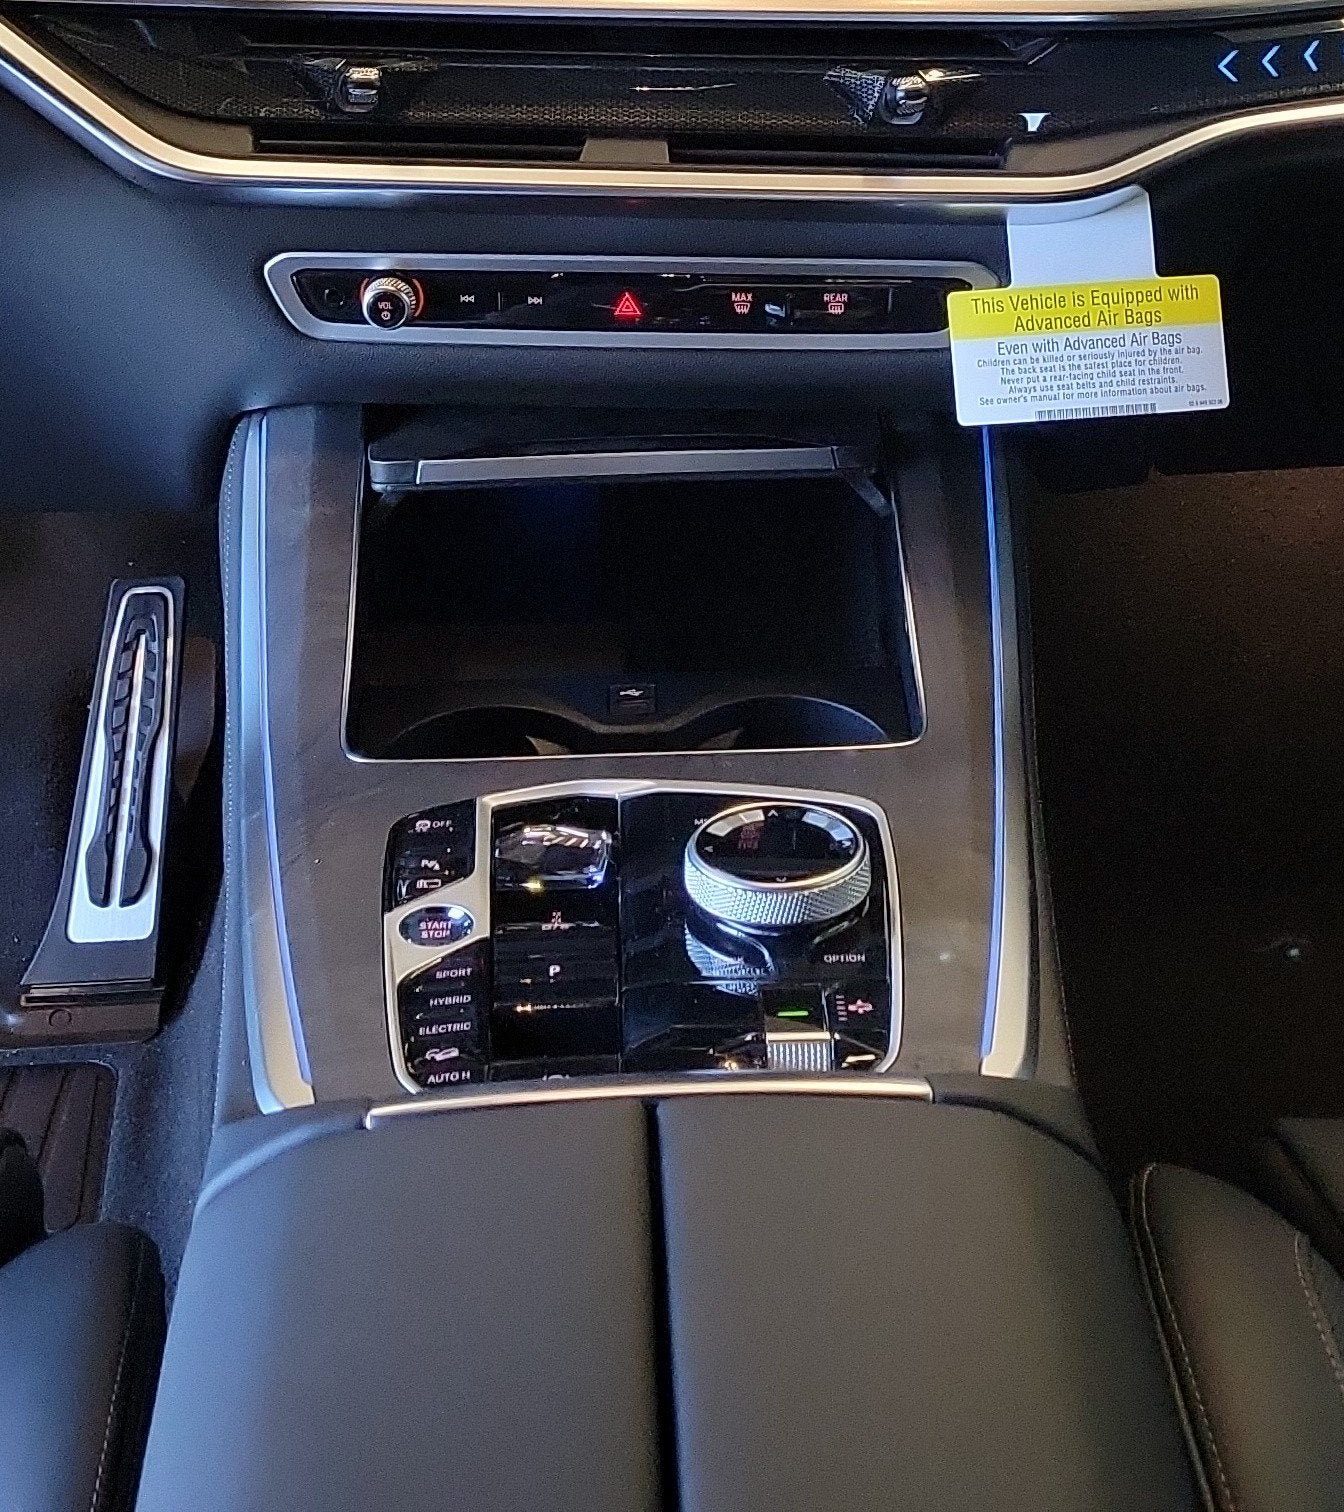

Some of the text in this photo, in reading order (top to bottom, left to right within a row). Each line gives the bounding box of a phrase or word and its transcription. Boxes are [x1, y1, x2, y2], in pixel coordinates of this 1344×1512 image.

[731, 292, 753, 302] MAX
[823, 292, 848, 303] REAR
[971, 284, 1199, 314] This Vehicle is Equipped with
[377, 301, 394, 311] VOL
[1014, 308, 1162, 332] Advanced Air Bags
[997, 331, 1182, 355] Even with Advanced Air Bags
[977, 356, 1011, 368] Children
[1013, 357, 1027, 365] can
[1030, 356, 1039, 364] be
[1042, 353, 1063, 363] killed
[1078, 349, 1114, 361] seriously
[1117, 348, 1145, 360] injured
[1148, 348, 1157, 359] by
[1160, 346, 1171, 355] the
[1174, 345, 1184, 354] air
[1187, 345, 1203, 355] bag.
[1001, 357, 1183, 376] The back seat is the safest place for children.
[1000, 376, 1024, 386] Never
[1026, 375, 1040, 385] put
[1050, 372, 1094, 382] rear-facing
[1096, 369, 1116, 378] child
[1119, 368, 1136, 377] seat
[1138, 367, 1146, 376] in
[1148, 366, 1160, 375] the
[1163, 365, 1184, 374] front.
[1009, 375, 1177, 394] Always use seat belts and child restraints.
[979, 383, 1207, 406] See owner's manual for more information about air bags.
[432, 819, 452, 828] OFF
[419, 921, 452, 930] START
[421, 930, 450, 938] STOP
[824, 953, 866, 963] OPTION
[436, 967, 472, 979] SPORT
[549, 965, 561, 977] P
[429, 994, 472, 1007] HYBRID
[419, 1021, 472, 1036] ELECTRIC
[427, 1070, 471, 1085] AUTO H
